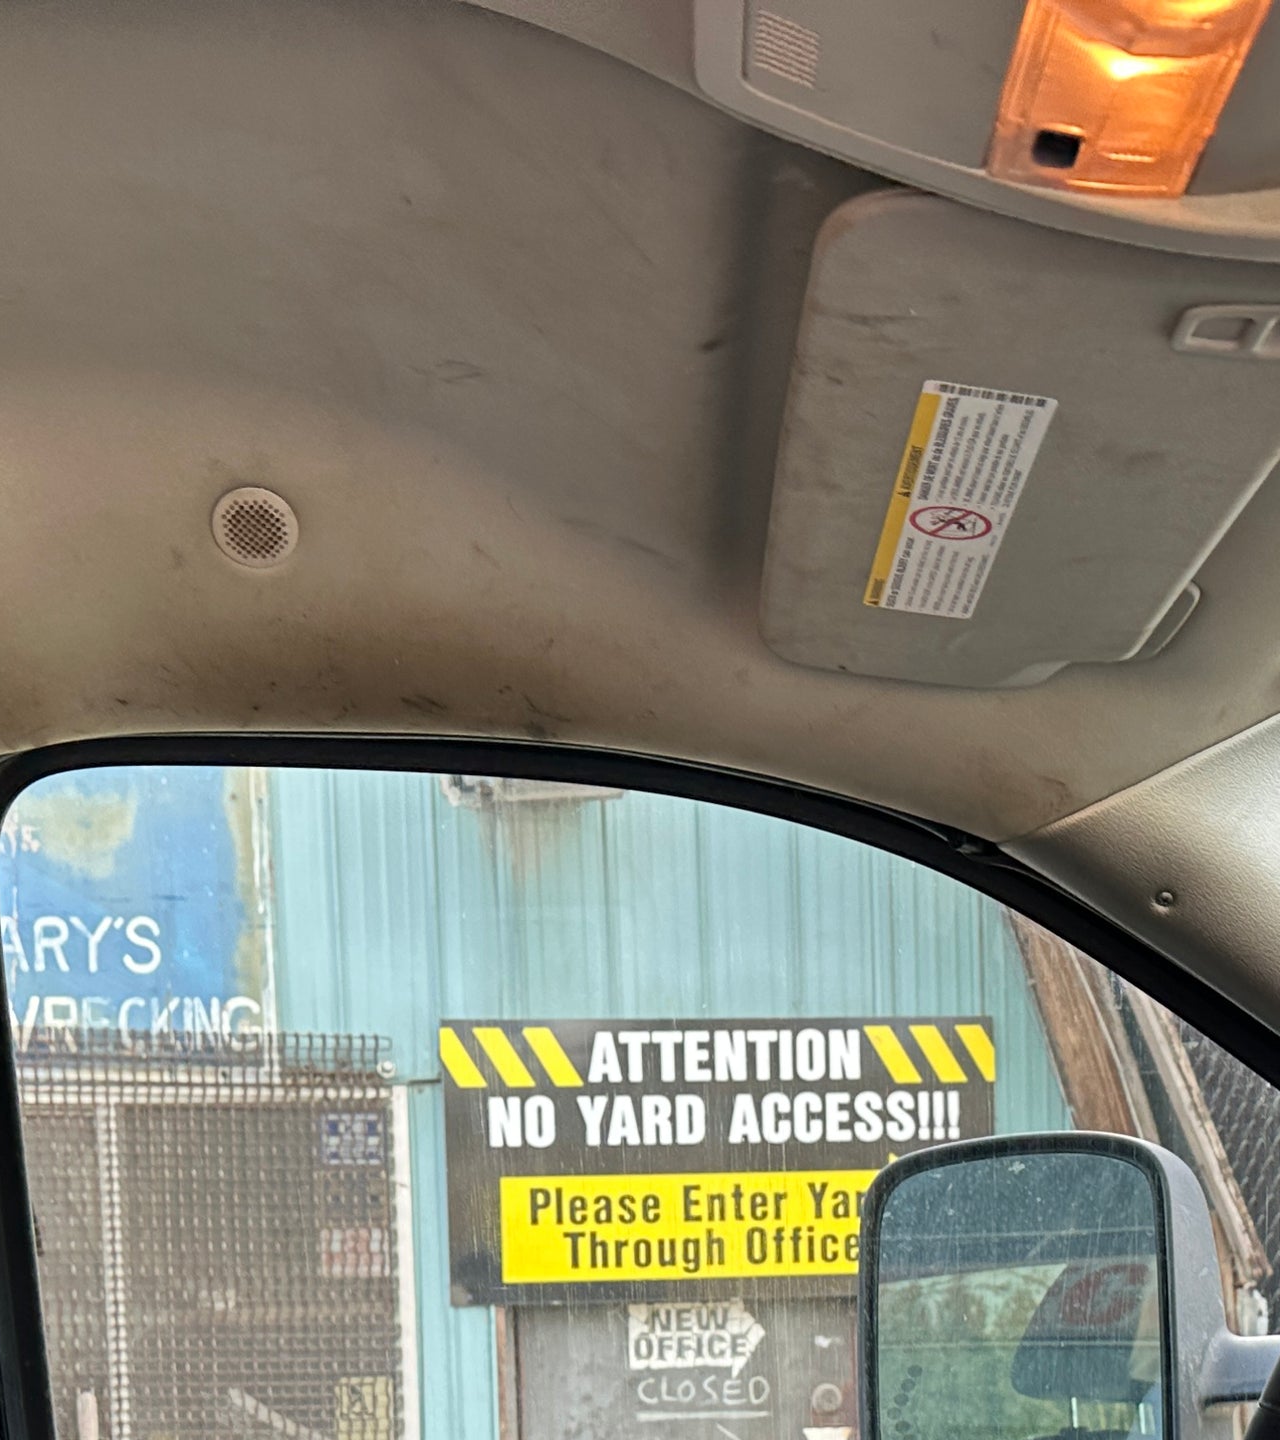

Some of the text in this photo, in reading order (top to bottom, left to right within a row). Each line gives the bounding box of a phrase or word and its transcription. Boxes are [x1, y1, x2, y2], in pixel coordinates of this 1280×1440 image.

[587, 1027, 862, 1084] ATTENTION
[488, 1090, 961, 1149] NO YARD ACCESS!!!
[529, 1182, 865, 1226] Please Enter Yar
[563, 1226, 859, 1273] Through Office
[648, 1308, 730, 1332] NEW
[634, 1334, 751, 1360] OFFICE
[637, 1375, 770, 1405] CLOSED
